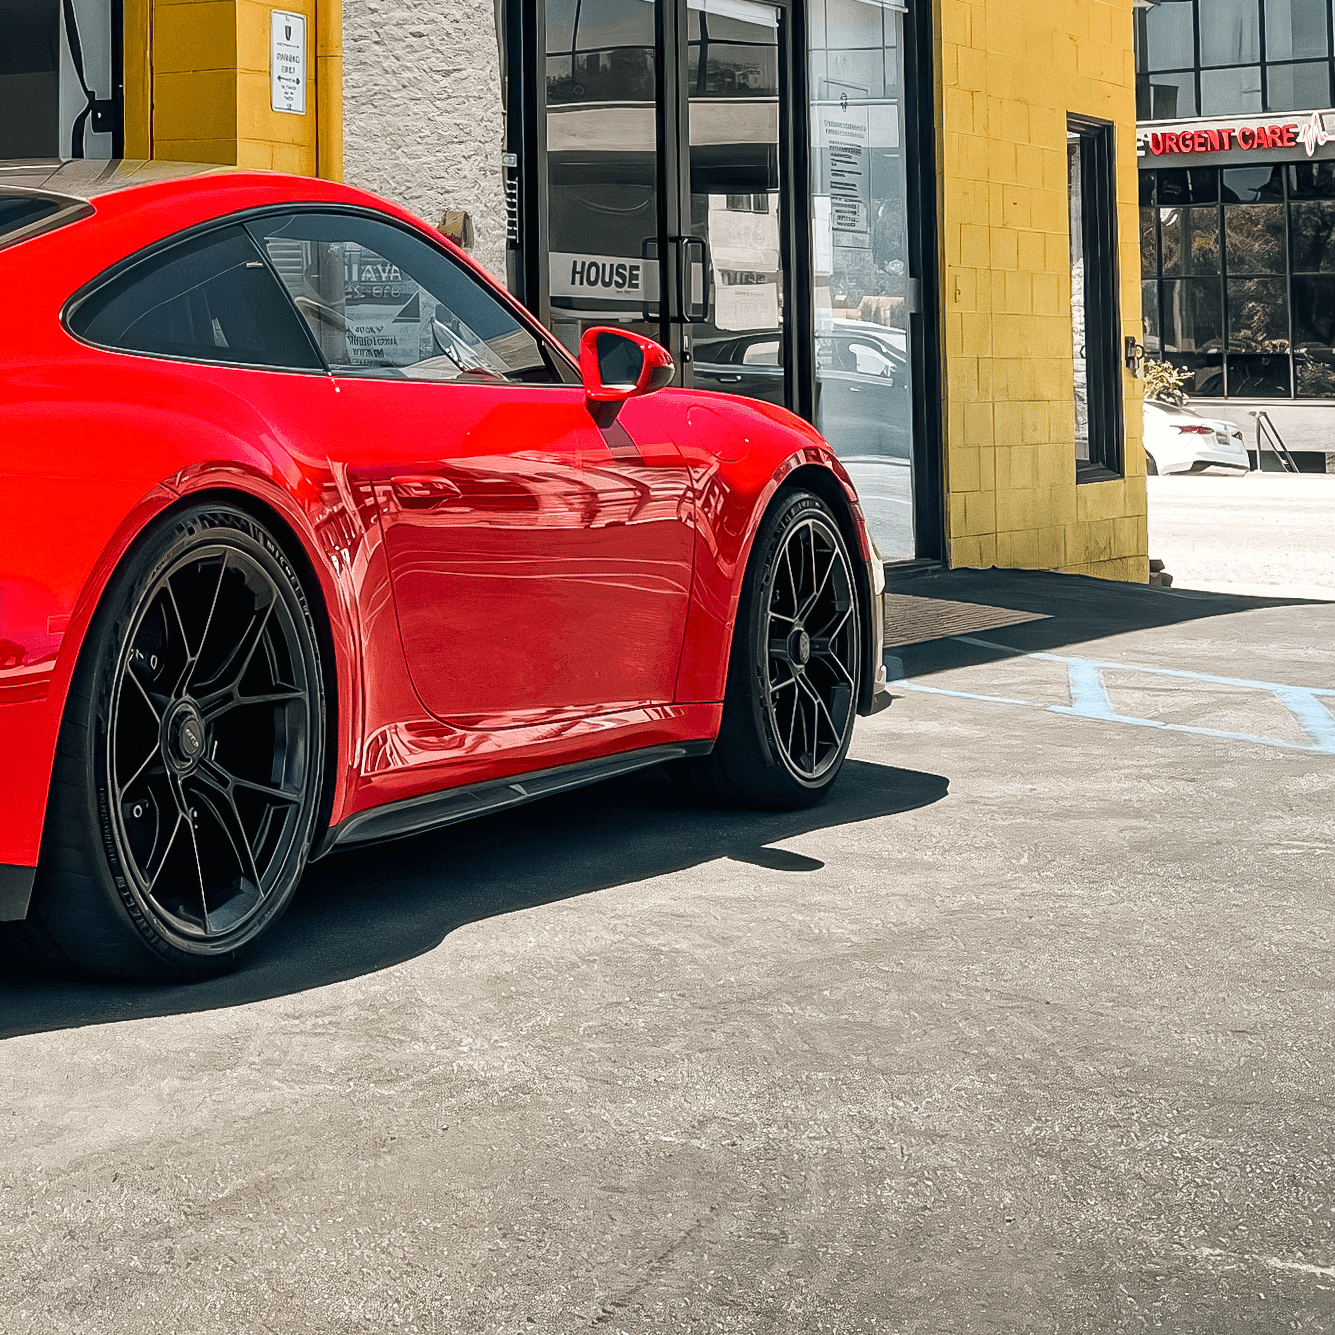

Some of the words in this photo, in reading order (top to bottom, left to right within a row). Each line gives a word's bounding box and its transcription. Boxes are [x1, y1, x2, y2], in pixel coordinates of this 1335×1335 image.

[1149, 129, 1235, 156] URGENT
[1237, 123, 1299, 151] CARE
[570, 259, 641, 290] HOUSE
